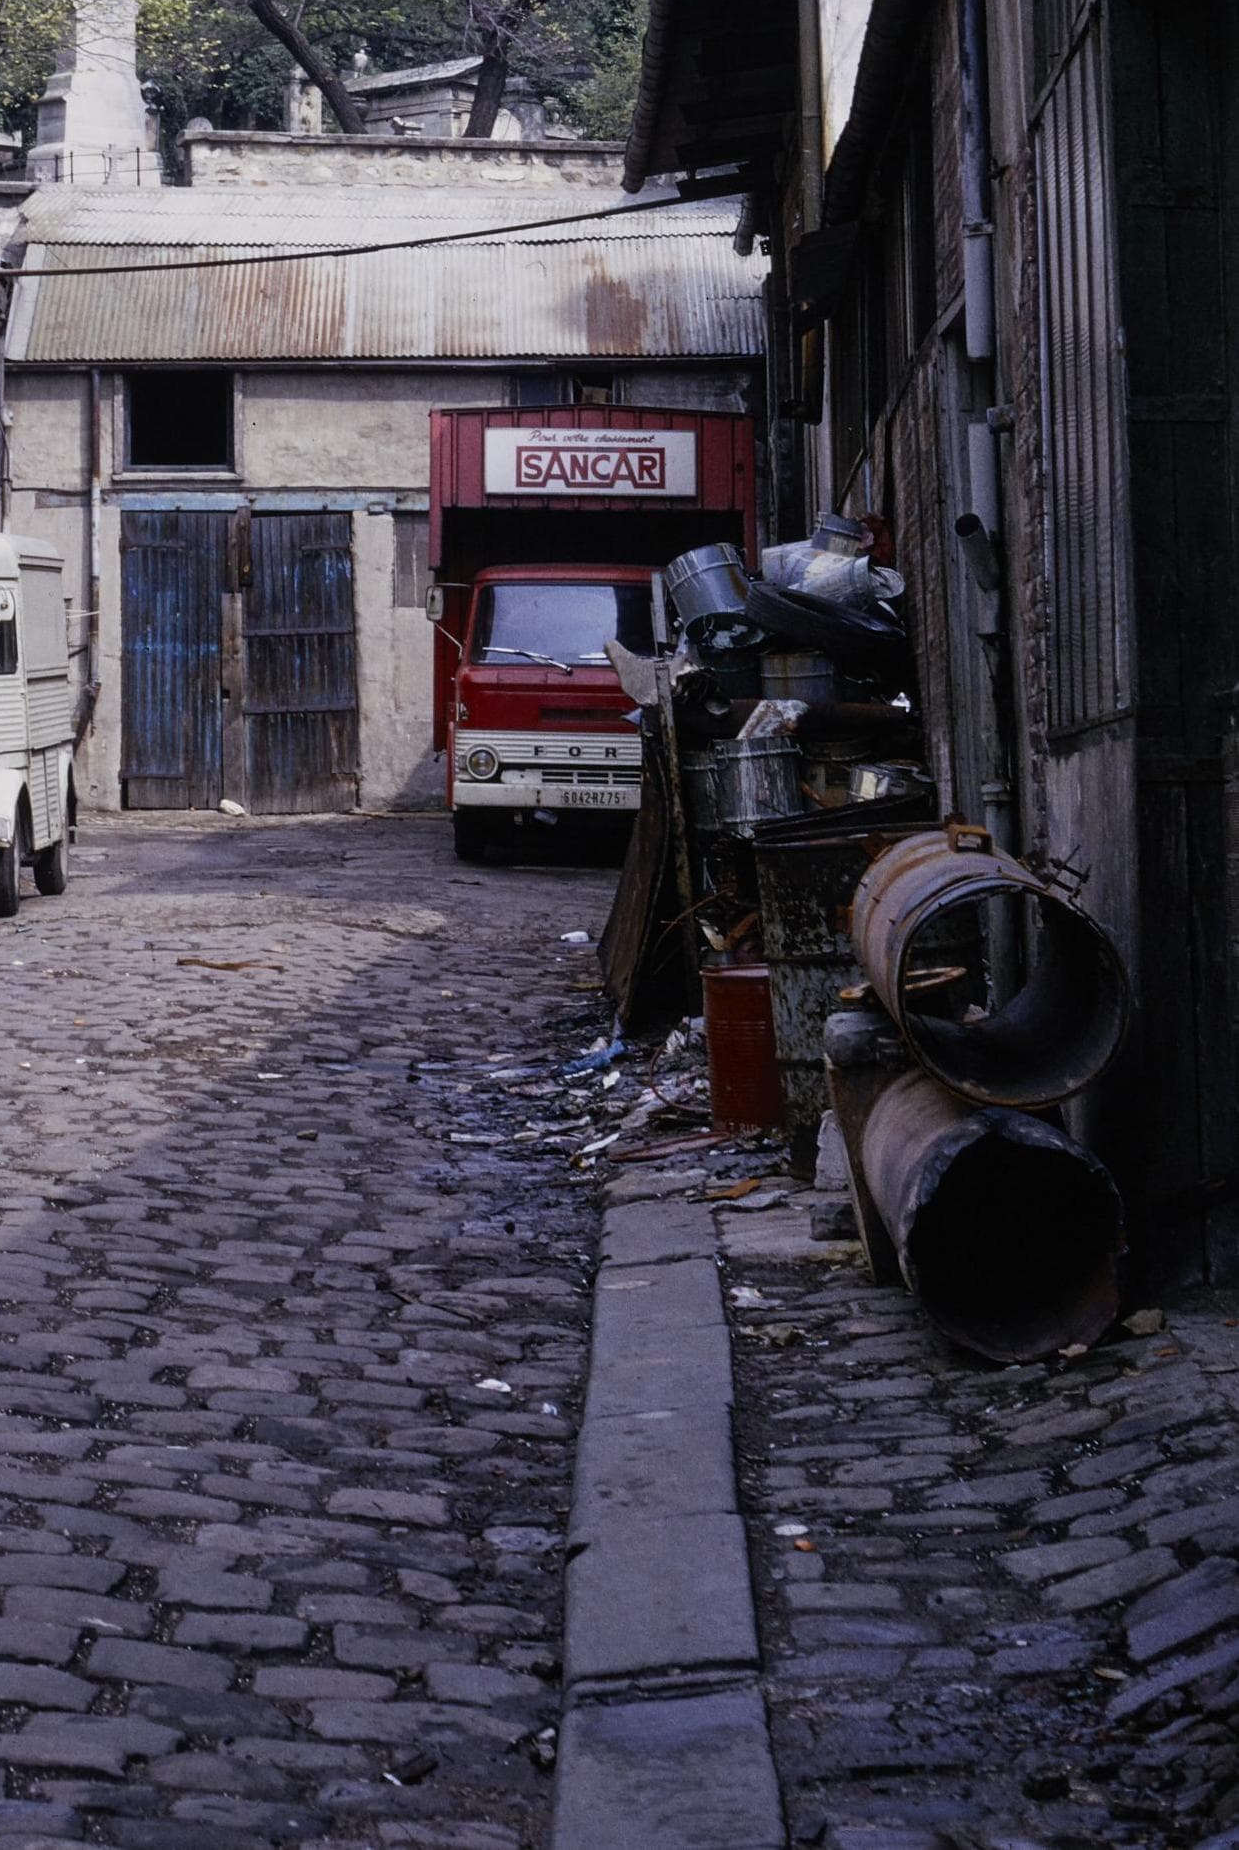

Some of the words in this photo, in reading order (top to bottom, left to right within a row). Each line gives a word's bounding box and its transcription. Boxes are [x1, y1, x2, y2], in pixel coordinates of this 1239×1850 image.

[528, 430, 556, 442] Pour
[522, 450, 659, 485] SANCAR
[533, 745, 618, 758] FOR
